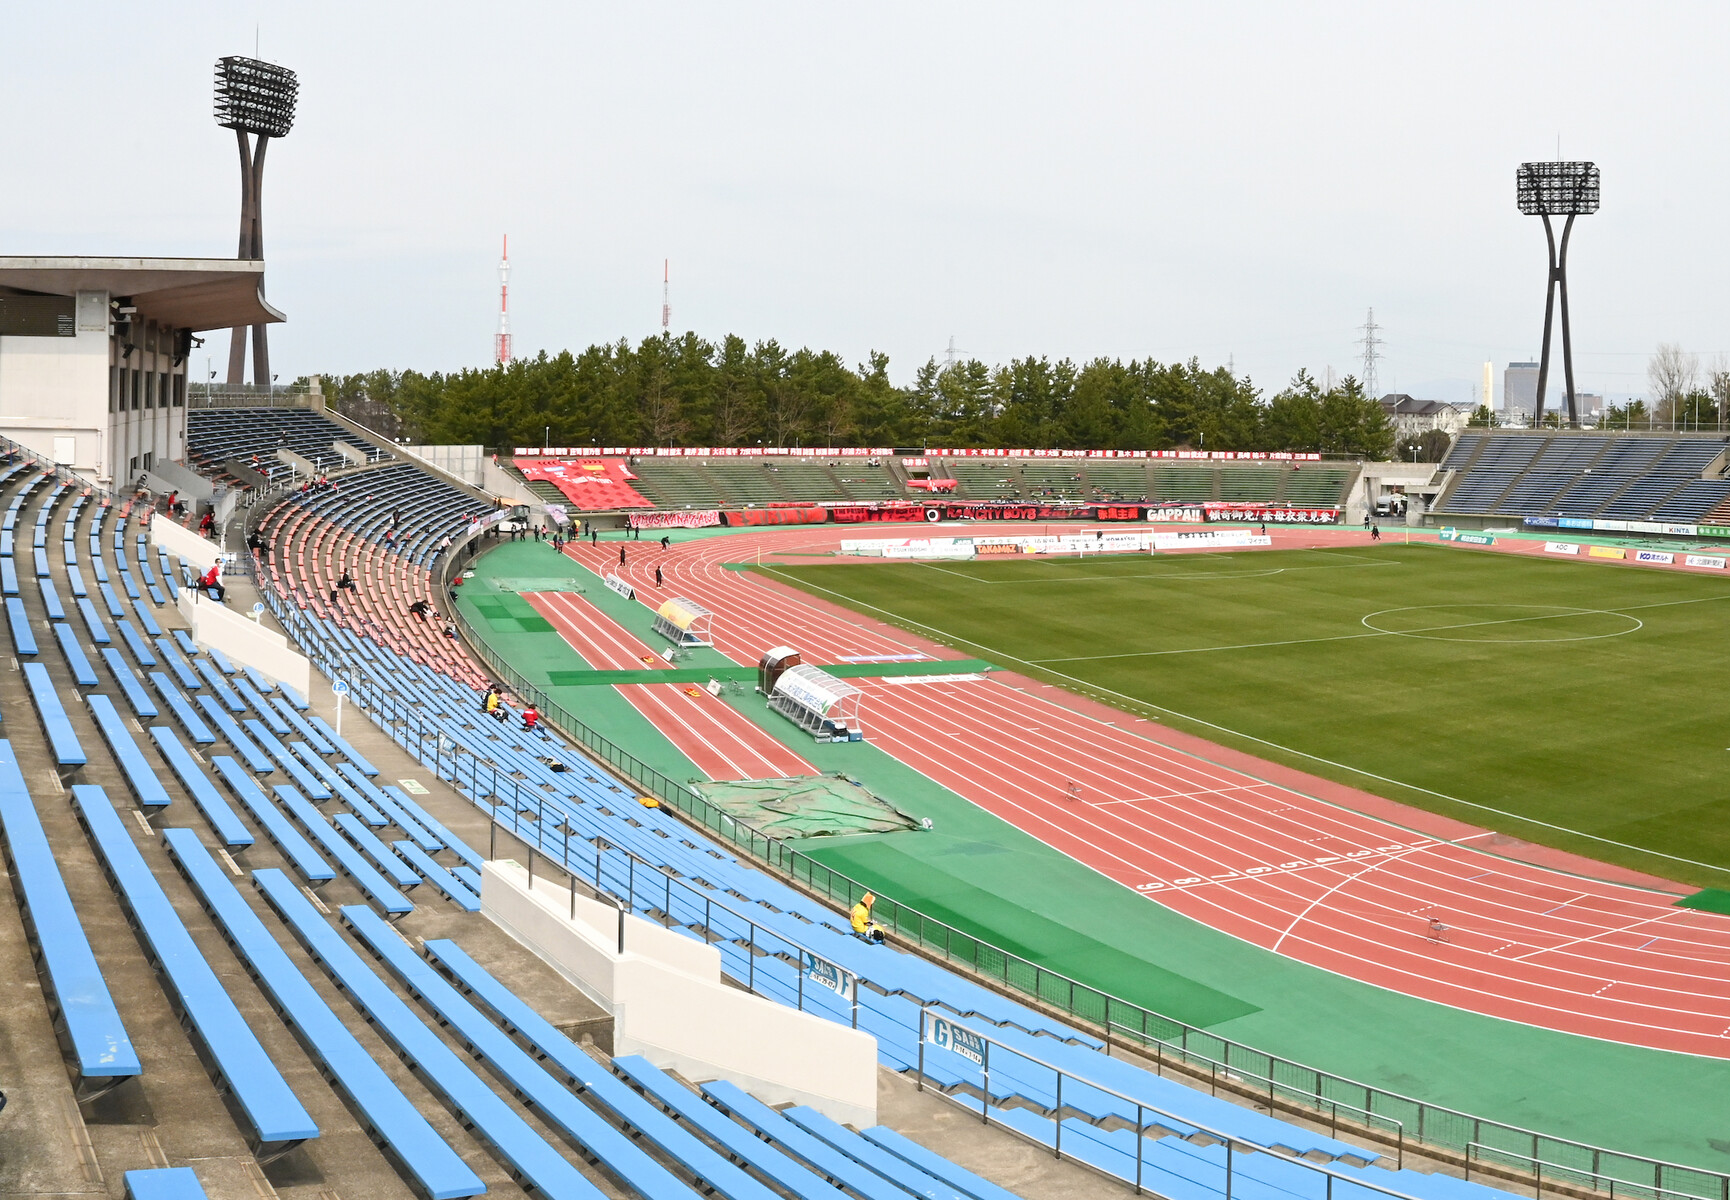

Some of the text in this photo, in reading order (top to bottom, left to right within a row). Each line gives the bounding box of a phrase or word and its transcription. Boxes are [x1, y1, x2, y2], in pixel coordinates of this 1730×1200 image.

[631, 513, 662, 526] VAMOS
[1003, 507, 1037, 520] BOYS
[1147, 508, 1201, 521] GAPPA!!
[1669, 527, 1690, 535] KINTA
[976, 544, 1018, 554] TAKAMAZ
[1173, 877, 1201, 885] 8
[1280, 861, 1308, 869] 5
[1314, 856, 1341, 864] 4
[1346, 850, 1372, 859] 3
[1376, 844, 1403, 852] 2
[840, 972, 849, 995] F
[934, 1019, 949, 1047] G
